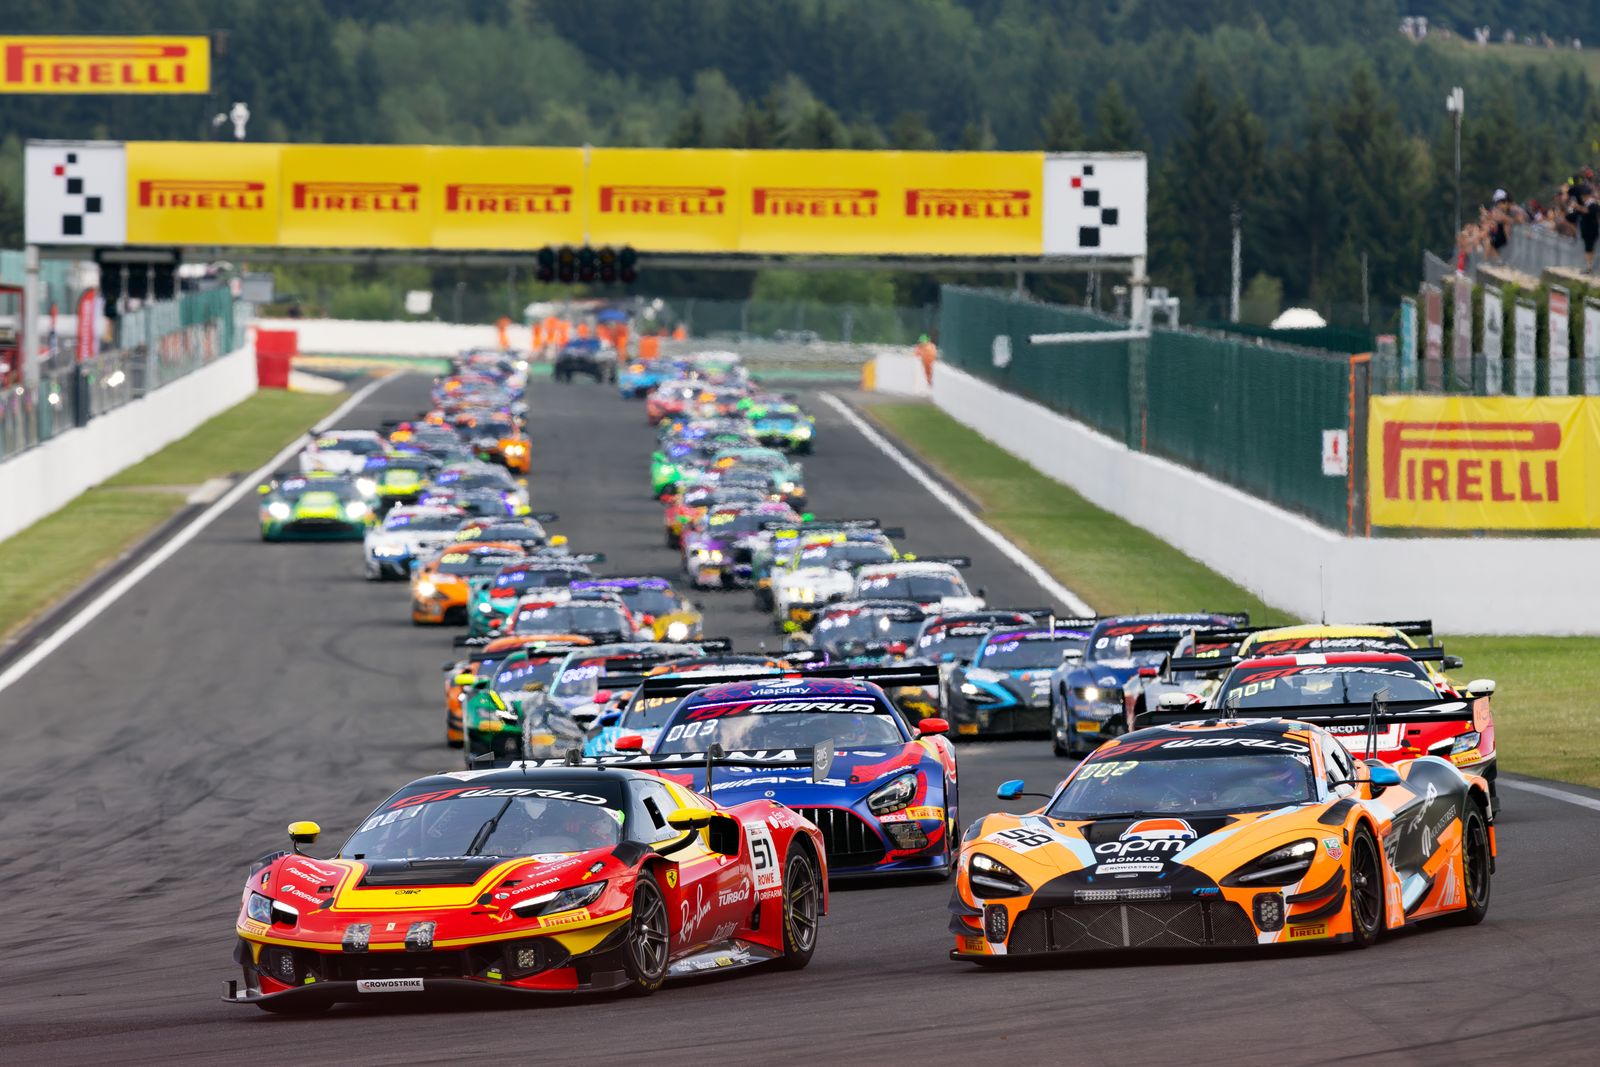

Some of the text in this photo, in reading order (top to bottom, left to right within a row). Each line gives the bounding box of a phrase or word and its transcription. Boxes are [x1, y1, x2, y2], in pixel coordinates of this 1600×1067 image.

[5, 44, 189, 84] PIRELLI
[138, 180, 265, 209] PIRELLI
[292, 182, 420, 211] PIRELLI
[445, 184, 573, 213] PIRELLI
[599, 186, 726, 215] PIRELLI
[753, 188, 878, 216] PIRELLI
[905, 189, 1031, 218] PIRELLI
[1383, 421, 1561, 502] PIRELLI
[750, 686, 811, 696] viaplay
[666, 719, 718, 742] 003
[1076, 760, 1139, 781] 002
[997, 829, 1055, 847] 58
[1095, 839, 1186, 857] apm
[751, 838, 773, 870] 51
[511, 877, 560, 895] ORIFARM
[758, 872, 774, 886] ROWE
[291, 889, 324, 905] ORIFARM
[760, 889, 783, 901] ORIFARM
[544, 912, 587, 927] PIRELLI
[1290, 924, 1325, 938] PIRELLI
[365, 980, 421, 988] CROWDSTRIKE
